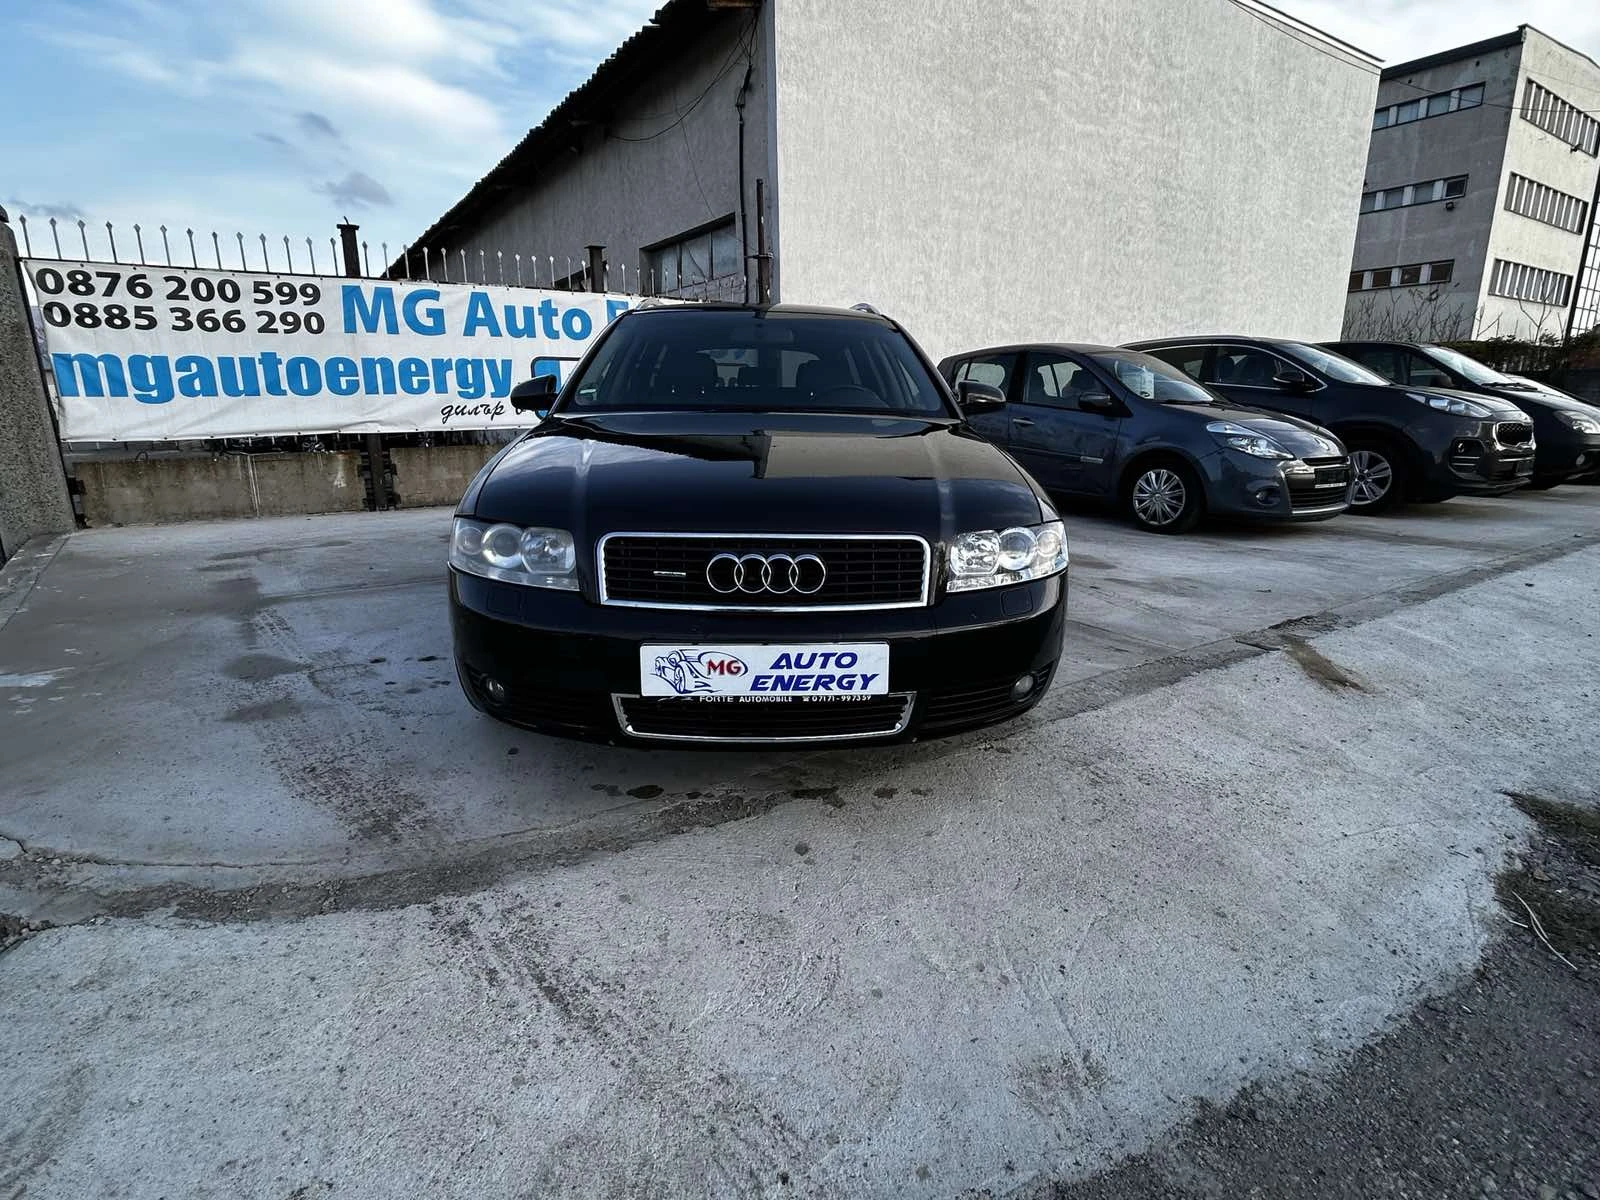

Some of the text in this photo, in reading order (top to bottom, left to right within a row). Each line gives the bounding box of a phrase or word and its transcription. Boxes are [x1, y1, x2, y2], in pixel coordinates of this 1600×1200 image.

[36, 268, 321, 306] 0876 200 599
[43, 301, 325, 334] 0885 366 290
[341, 285, 446, 336] MG
[463, 292, 593, 341] Auto
[51, 352, 512, 404] mgautoenergy
[441, 401, 505, 424] дилър
[707, 659, 741, 676] MG
[769, 652, 858, 670] AUTO
[750, 674, 880, 692] ENERGY
[699, 695, 735, 703] FORTE
[739, 695, 793, 703] AUTOMOBILE
